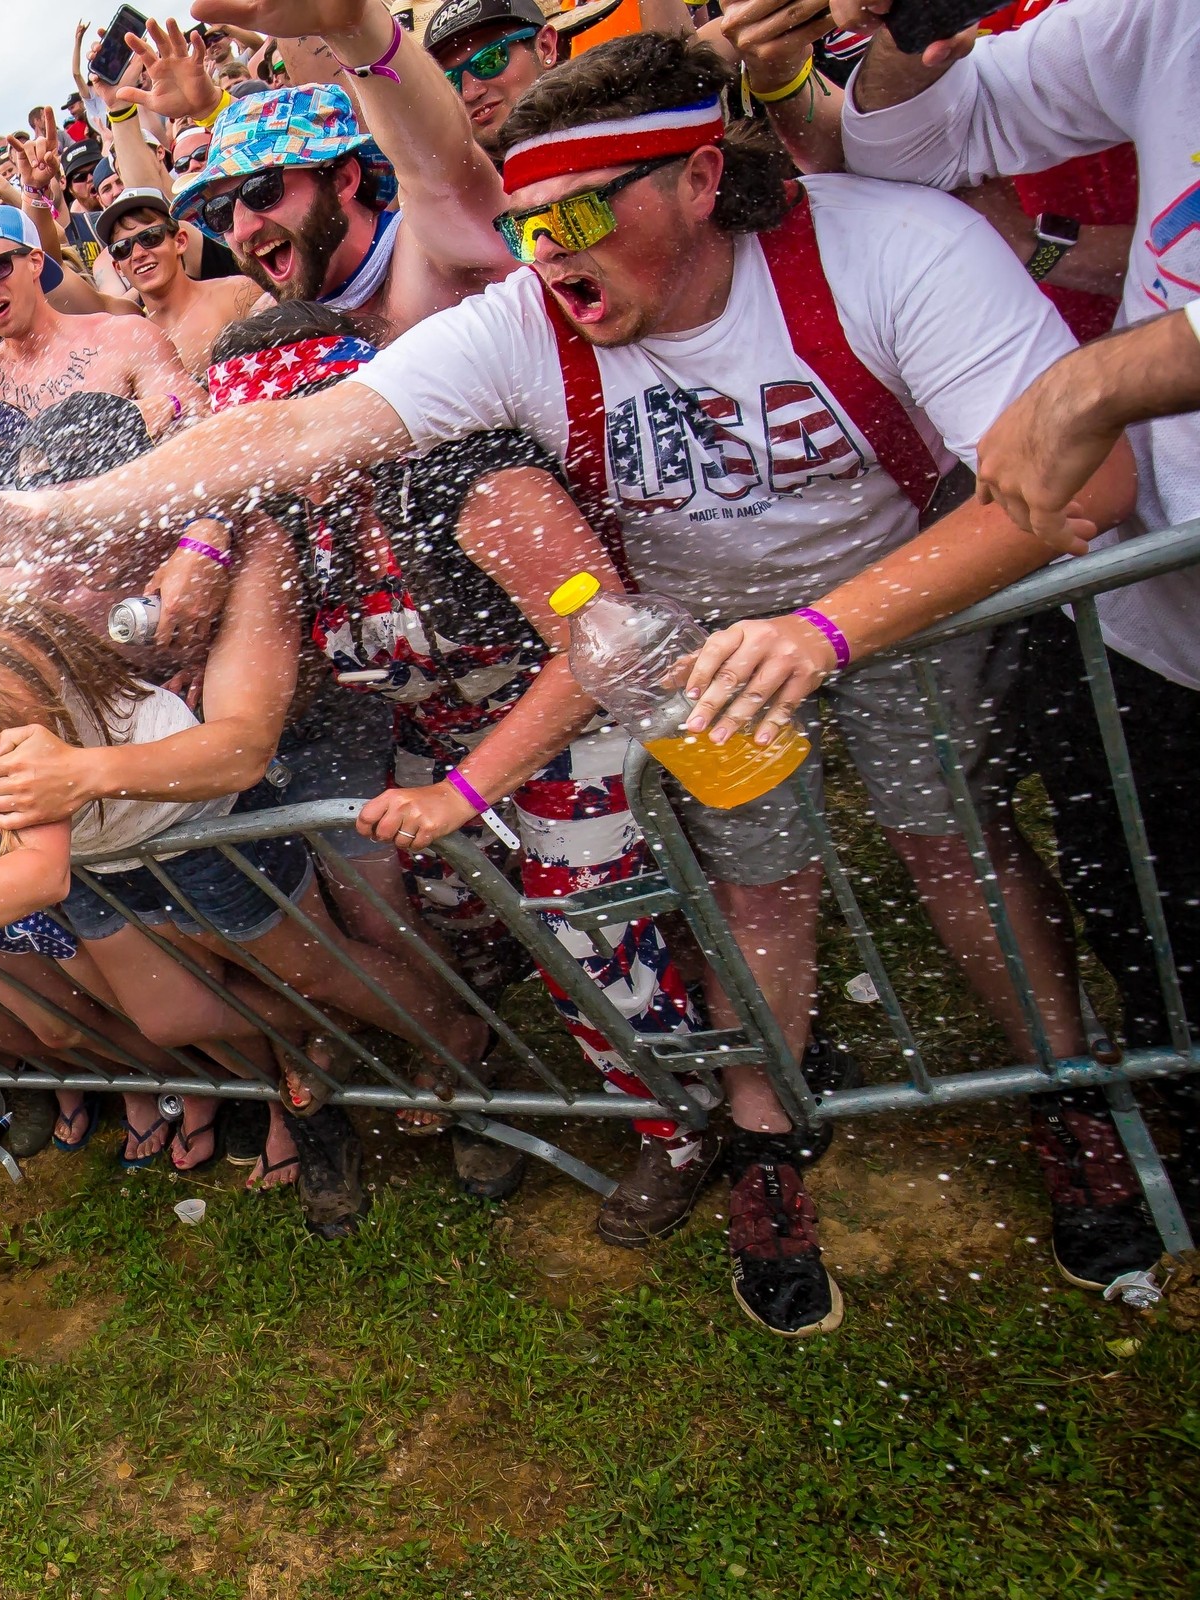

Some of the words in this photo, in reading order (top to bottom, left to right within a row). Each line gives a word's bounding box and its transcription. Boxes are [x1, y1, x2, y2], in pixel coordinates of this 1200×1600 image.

[605, 379, 869, 516] USA
[689, 506, 713, 522] MADE
[721, 506, 733, 519] IN
[736, 497, 772, 517] AMERI
[765, 1165, 779, 1195] NIKE
